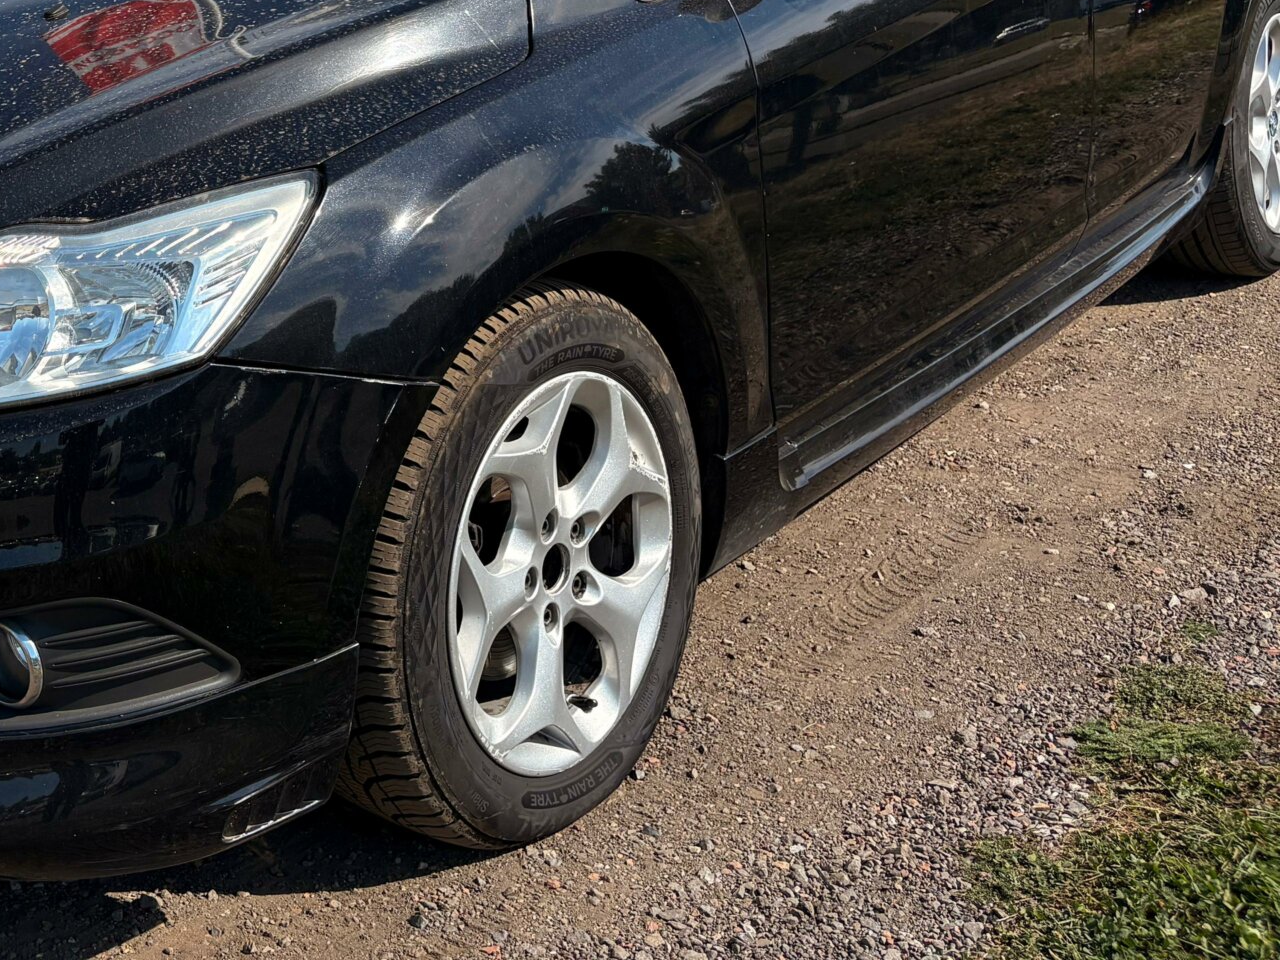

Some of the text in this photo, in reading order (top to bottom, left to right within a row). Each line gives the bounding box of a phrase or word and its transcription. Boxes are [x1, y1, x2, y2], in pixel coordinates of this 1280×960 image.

[534, 345, 618, 378] THE RAIN TYRE
[530, 757, 618, 807] THE RAIN TYRE
